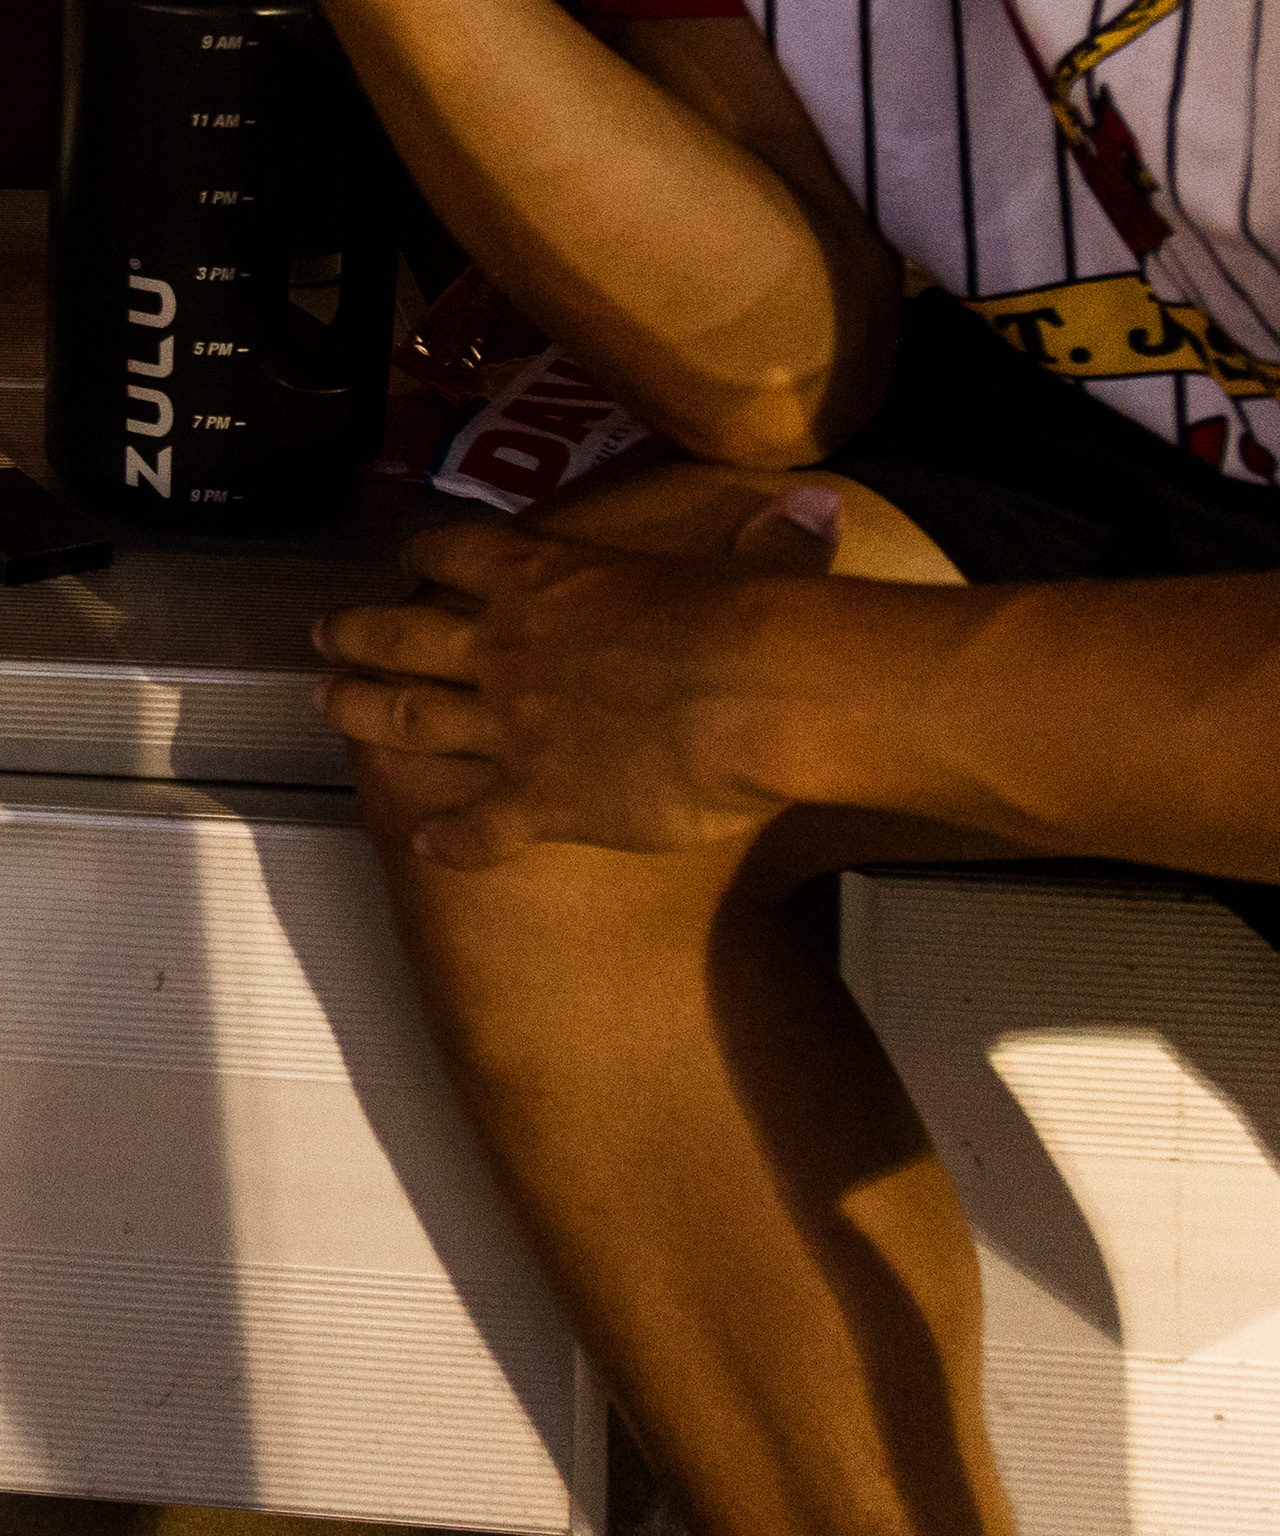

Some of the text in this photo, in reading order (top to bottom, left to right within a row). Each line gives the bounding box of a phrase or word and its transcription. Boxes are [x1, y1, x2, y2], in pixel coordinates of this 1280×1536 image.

[201, 35, 243, 50] 9 AM
[192, 113, 240, 128] 11 AM
[212, 191, 238, 205] PM
[196, 268, 236, 282] 3 PM
[194, 342, 233, 357] 5 PM
[125, 275, 177, 499] ZULU
[193, 415, 230, 430] 7 PM
[191, 489, 228, 503] 9 PM
